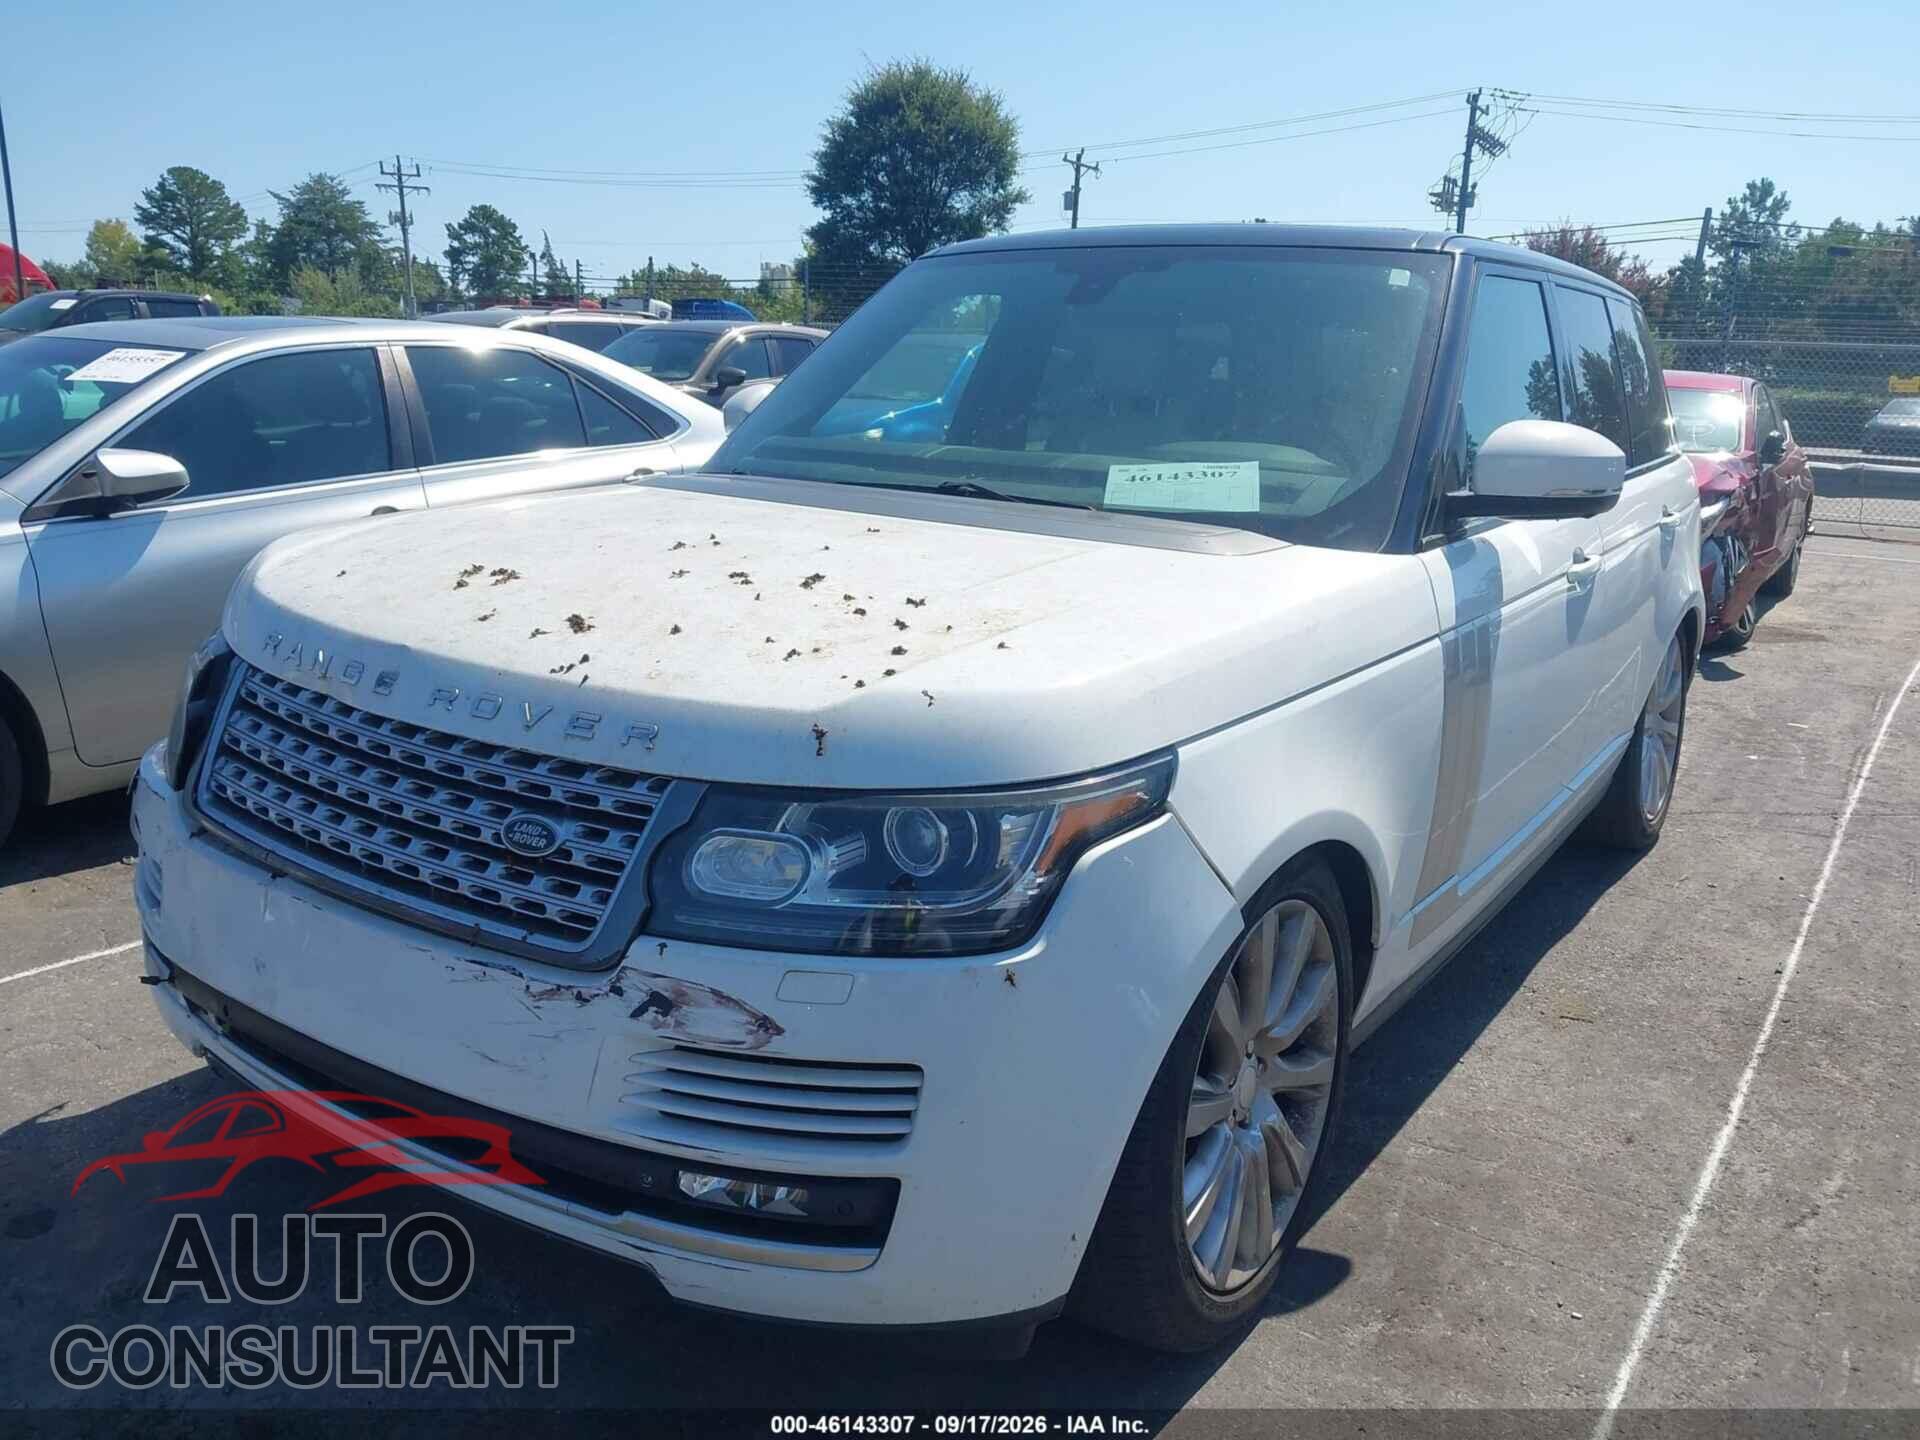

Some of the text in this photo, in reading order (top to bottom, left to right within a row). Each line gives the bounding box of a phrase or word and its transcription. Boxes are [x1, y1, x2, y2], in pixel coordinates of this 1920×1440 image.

[1124, 470, 1238, 483] 46143307
[262, 632, 661, 752] RANGE ROVER
